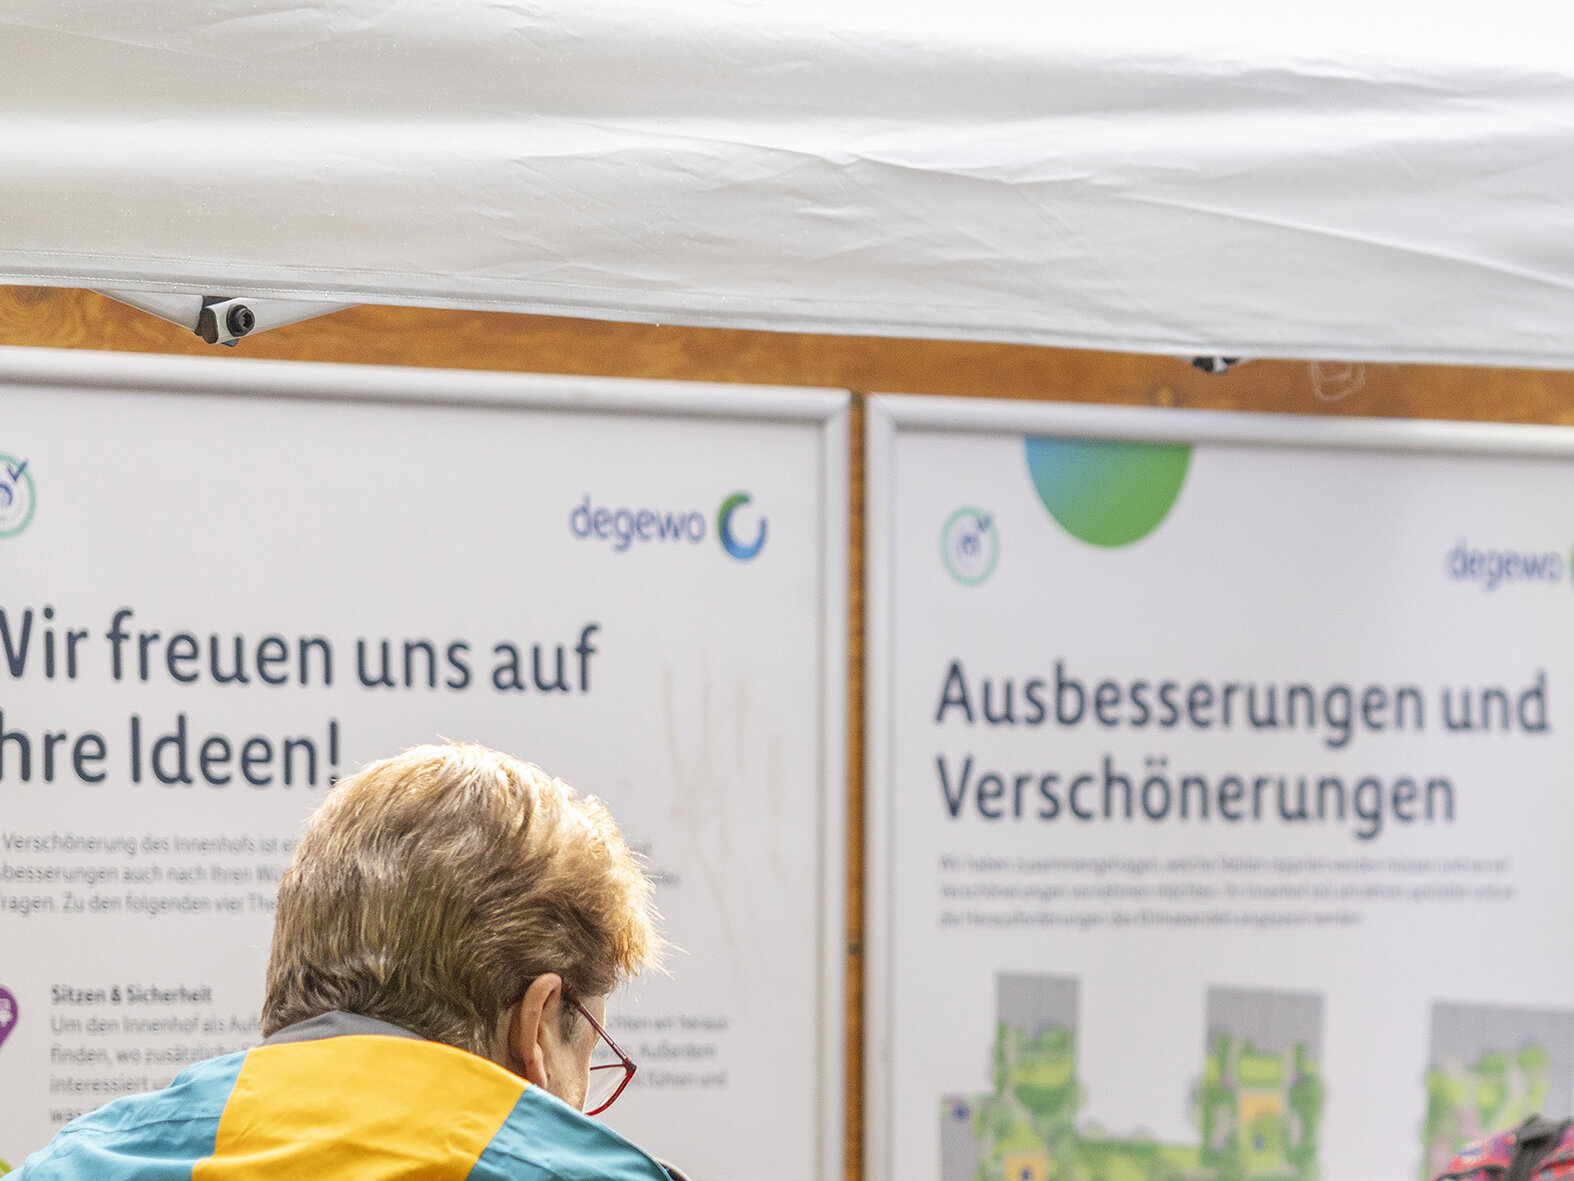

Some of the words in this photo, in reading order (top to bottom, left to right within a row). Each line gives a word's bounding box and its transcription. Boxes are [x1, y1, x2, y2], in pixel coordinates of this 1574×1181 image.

[569, 493, 707, 553] degewo
[1445, 536, 1564, 592] degewo
[106, 607, 334, 686] freuen
[356, 637, 473, 690] uns
[492, 623, 601, 693] auf
[934, 659, 1426, 749] Ausbesserungen
[1442, 668, 1551, 734] und
[0, 708, 107, 785] hre
[130, 712, 341, 787] Ideen!
[934, 754, 1457, 841] Verschönerungen
[2, 831, 137, 857] Verschönerung
[141, 833, 170, 854] des
[0, 861, 118, 887] besserungen
[122, 863, 163, 882] auch
[166, 864, 208, 883] nach
[0, 893, 57, 916] ragen.
[62, 890, 85, 913] Zu
[88, 893, 123, 913] den
[125, 892, 212, 916] folgenden
[215, 894, 244, 914] vier
[51, 984, 107, 1004] Sitzen
[110, 984, 122, 1003] &
[126, 984, 213, 1005] Sicherheit
[51, 1014, 82, 1035] Um
[86, 1014, 120, 1034] den
[123, 1013, 200, 1034] Innenhof
[203, 1013, 226, 1034] als
[51, 1074, 148, 1095] interessiert
